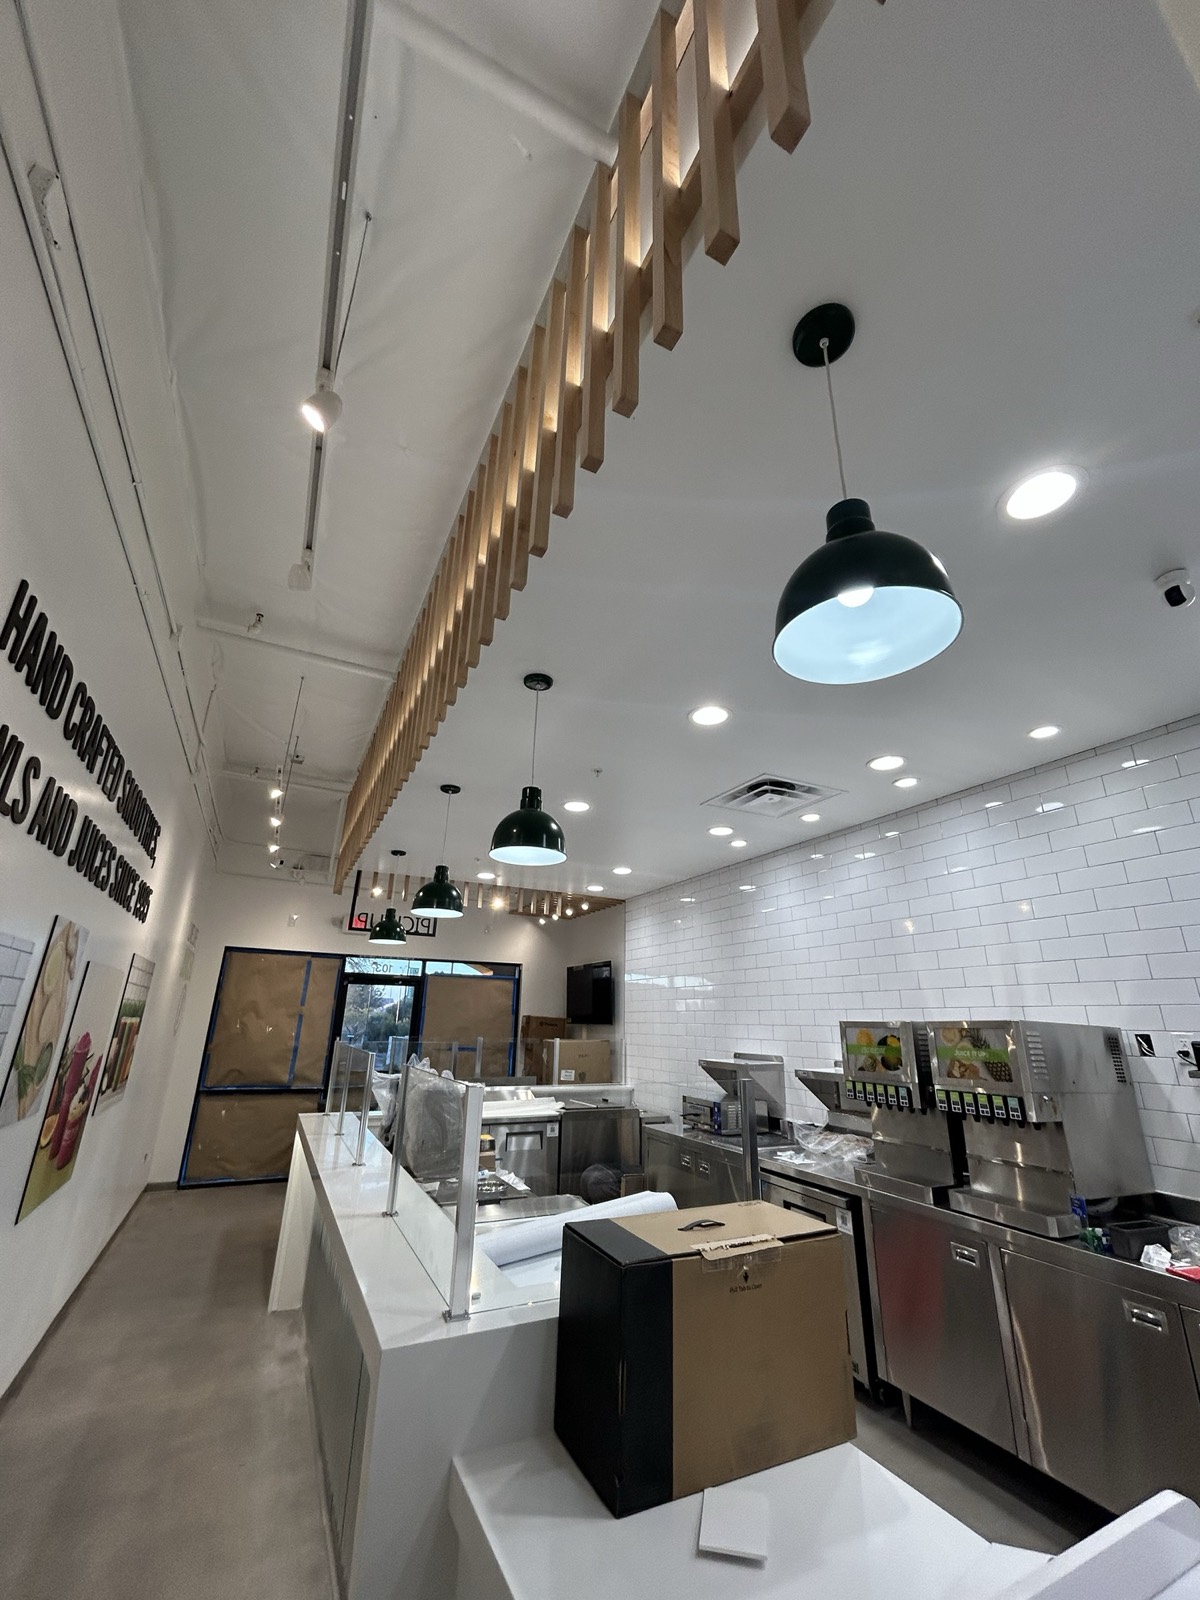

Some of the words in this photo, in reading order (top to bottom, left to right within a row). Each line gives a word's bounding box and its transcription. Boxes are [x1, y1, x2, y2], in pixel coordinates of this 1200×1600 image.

[0, 579, 74, 720] HAND
[63, 681, 125, 802] CRAFTED
[27, 776, 78, 857] AND
[68, 815, 117, 892] JUICES
[108, 854, 140, 912] SINCE
